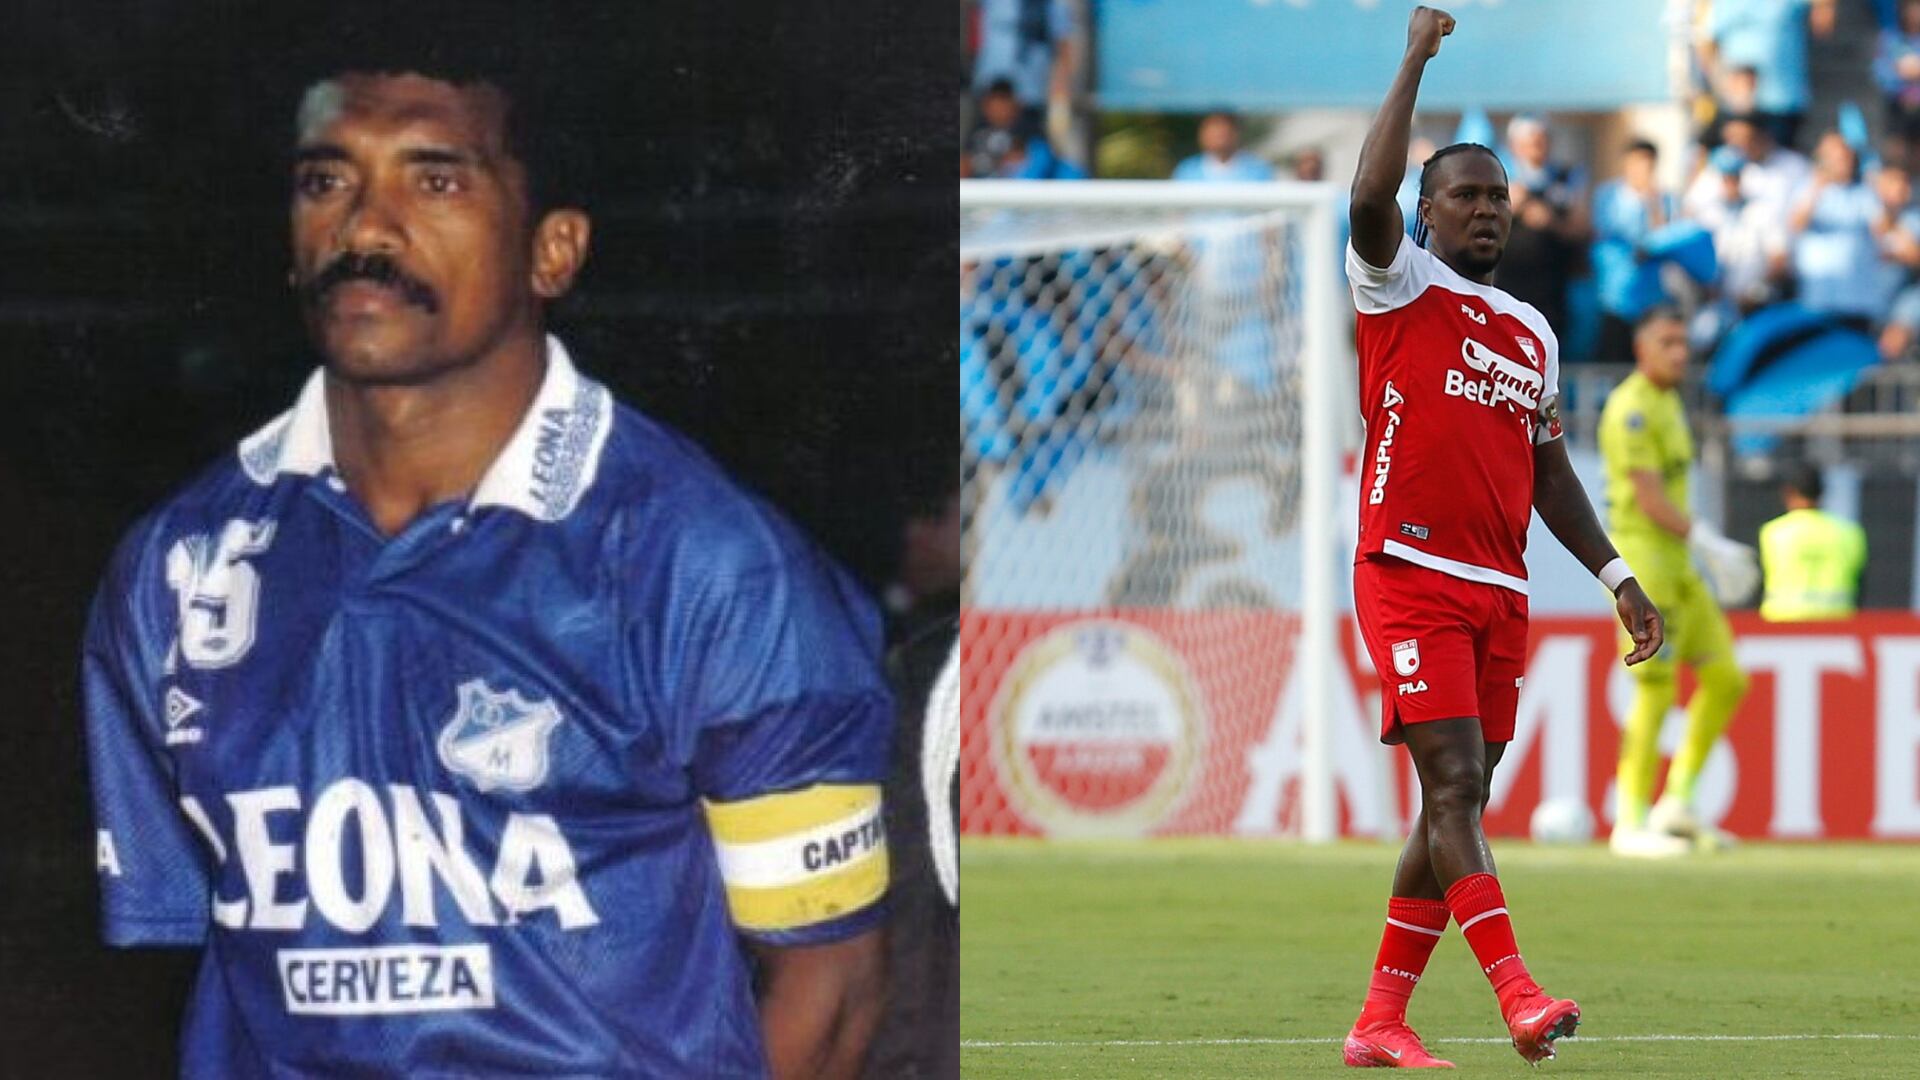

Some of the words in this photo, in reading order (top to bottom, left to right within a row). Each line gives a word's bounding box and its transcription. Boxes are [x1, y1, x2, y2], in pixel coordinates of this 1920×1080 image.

[1461, 303, 1487, 325] FILA
[1369, 411, 1401, 505] BetPlay
[1398, 680, 1428, 696] FILA
[180, 776, 600, 934] LEONA
[286, 956, 480, 1003] CERVEZA
